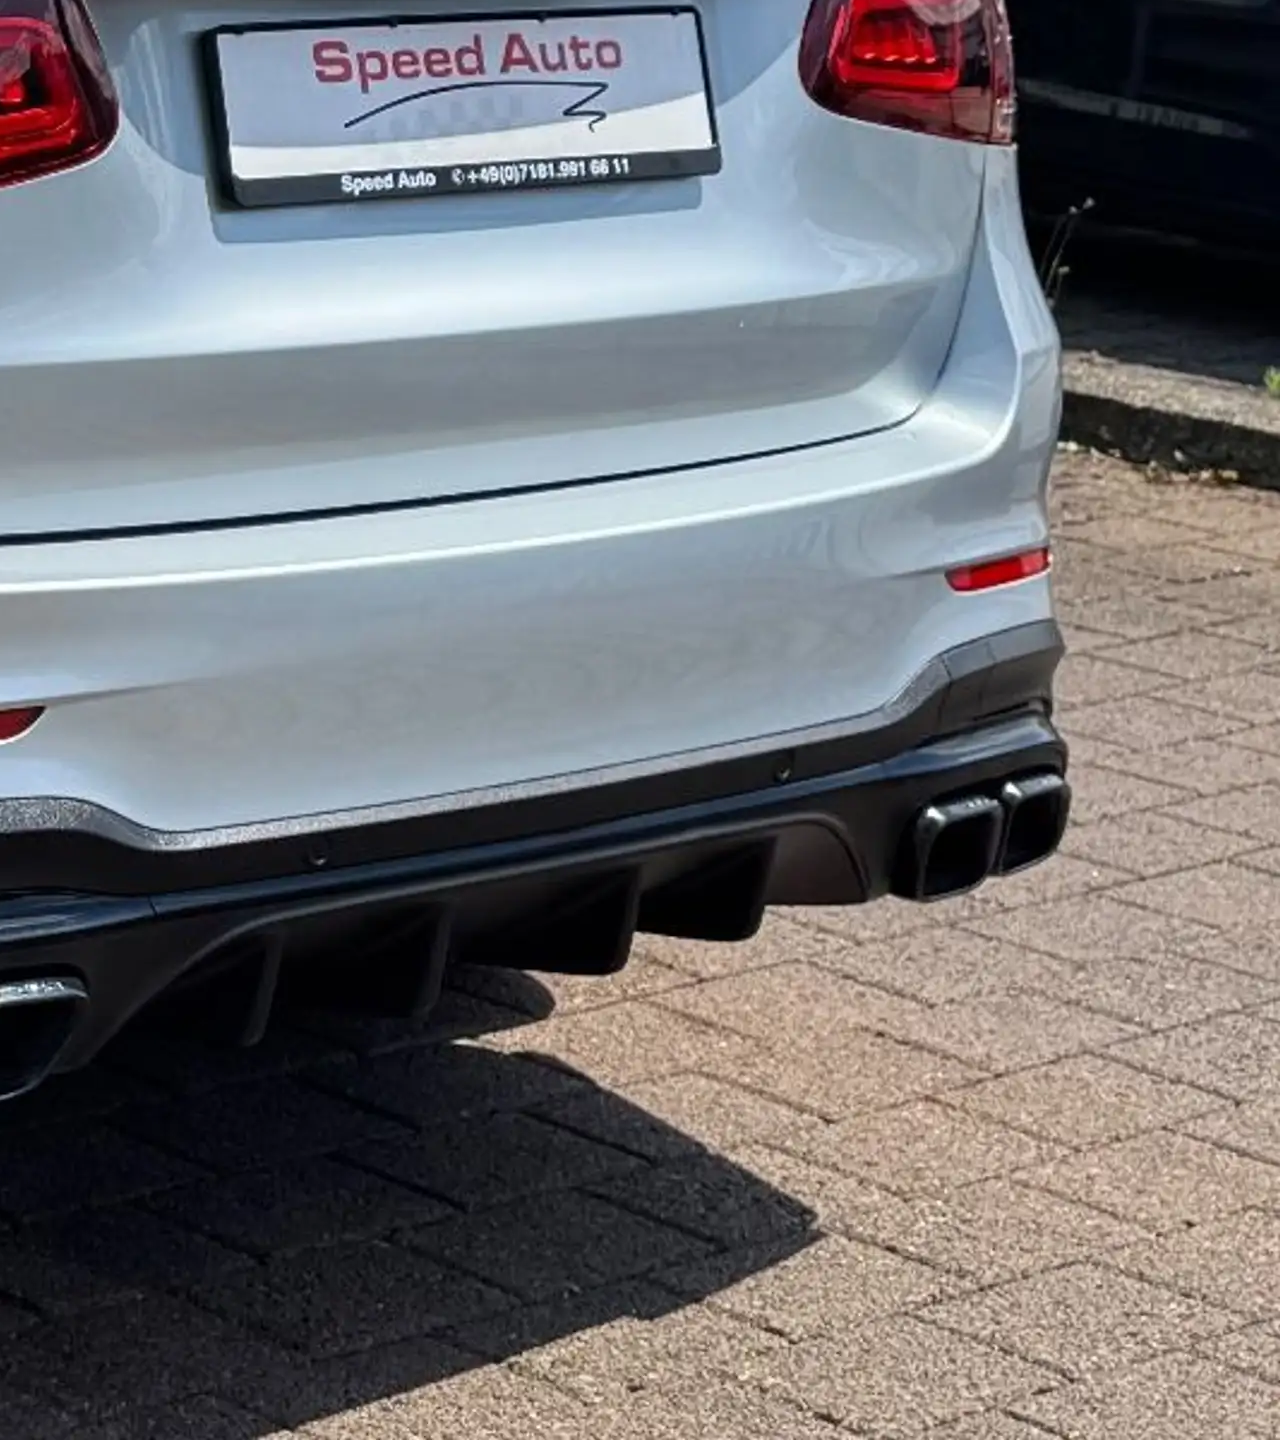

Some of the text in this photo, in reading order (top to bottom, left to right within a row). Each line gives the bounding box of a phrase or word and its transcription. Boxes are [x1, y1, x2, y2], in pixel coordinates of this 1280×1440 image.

[311, 31, 624, 95] Speed Auto
[340, 172, 395, 196] Speed
[397, 170, 437, 190] Auto
[612, 157, 631, 175] 11
